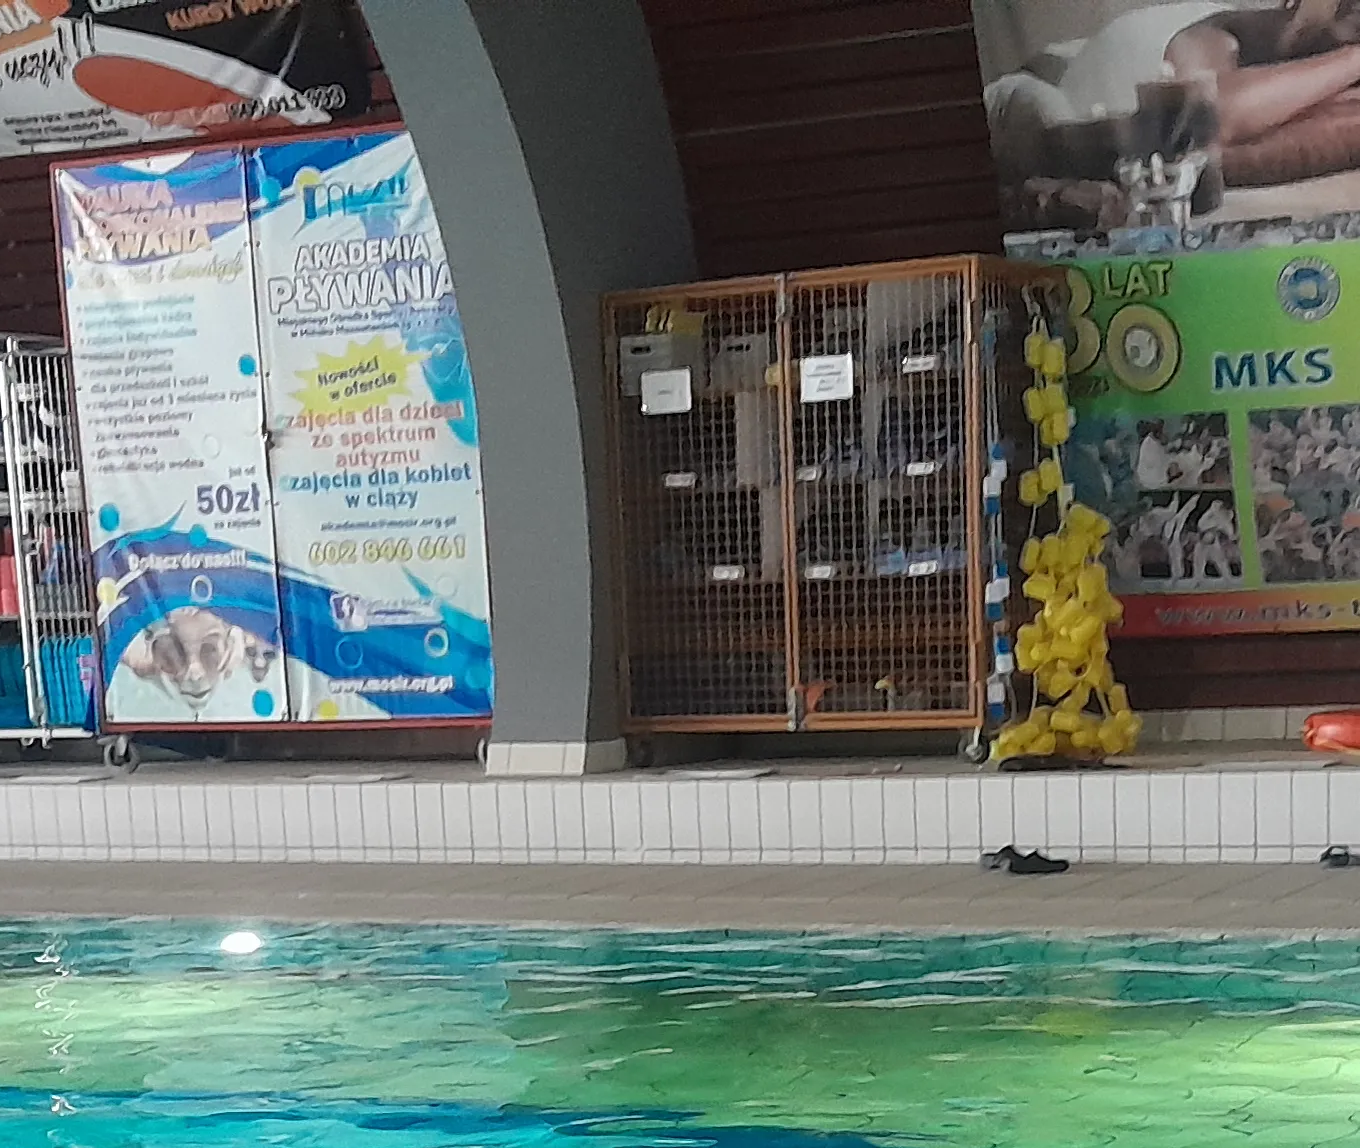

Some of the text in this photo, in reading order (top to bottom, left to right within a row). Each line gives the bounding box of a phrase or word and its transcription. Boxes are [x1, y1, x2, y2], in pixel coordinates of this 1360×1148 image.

[295, 232, 431, 273] AKADEMIA
[268, 260, 456, 315] PŁYWANIA
[1103, 260, 1173, 298] LAT
[317, 355, 380, 388] Nowości
[344, 371, 397, 398] ofercie
[1212, 346, 1333, 392] MKS
[289, 401, 463, 432] zajęcia dla dzieci
[311, 425, 436, 450] ze spektrum
[336, 449, 421, 469] autyzmu
[290, 462, 472, 495] zajęcia dla kobiet
[197, 482, 260, 515] 50zł
[345, 487, 419, 510] w ciąży
